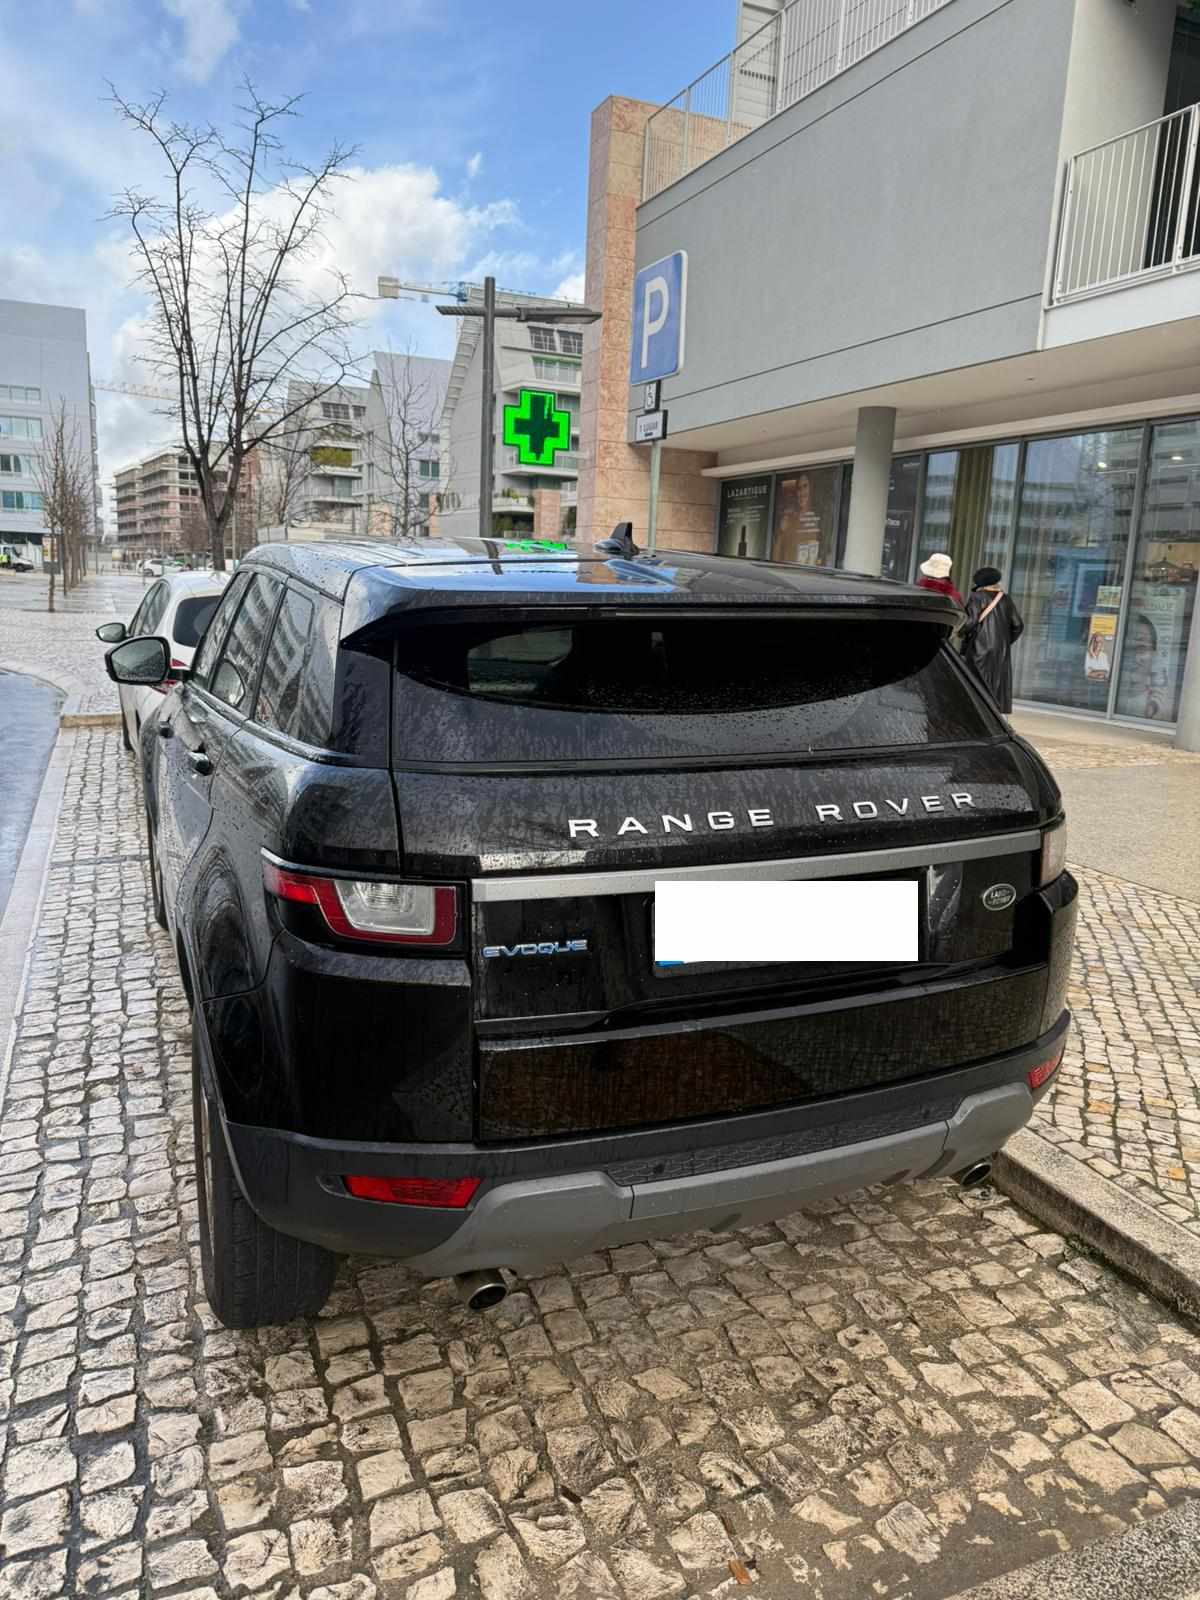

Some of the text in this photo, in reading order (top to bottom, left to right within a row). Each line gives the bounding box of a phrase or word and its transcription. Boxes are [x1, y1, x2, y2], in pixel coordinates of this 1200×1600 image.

[640, 275, 670, 369] P
[567, 792, 977, 838] RANGE ROVER
[482, 939, 589, 958] EVOQUE
